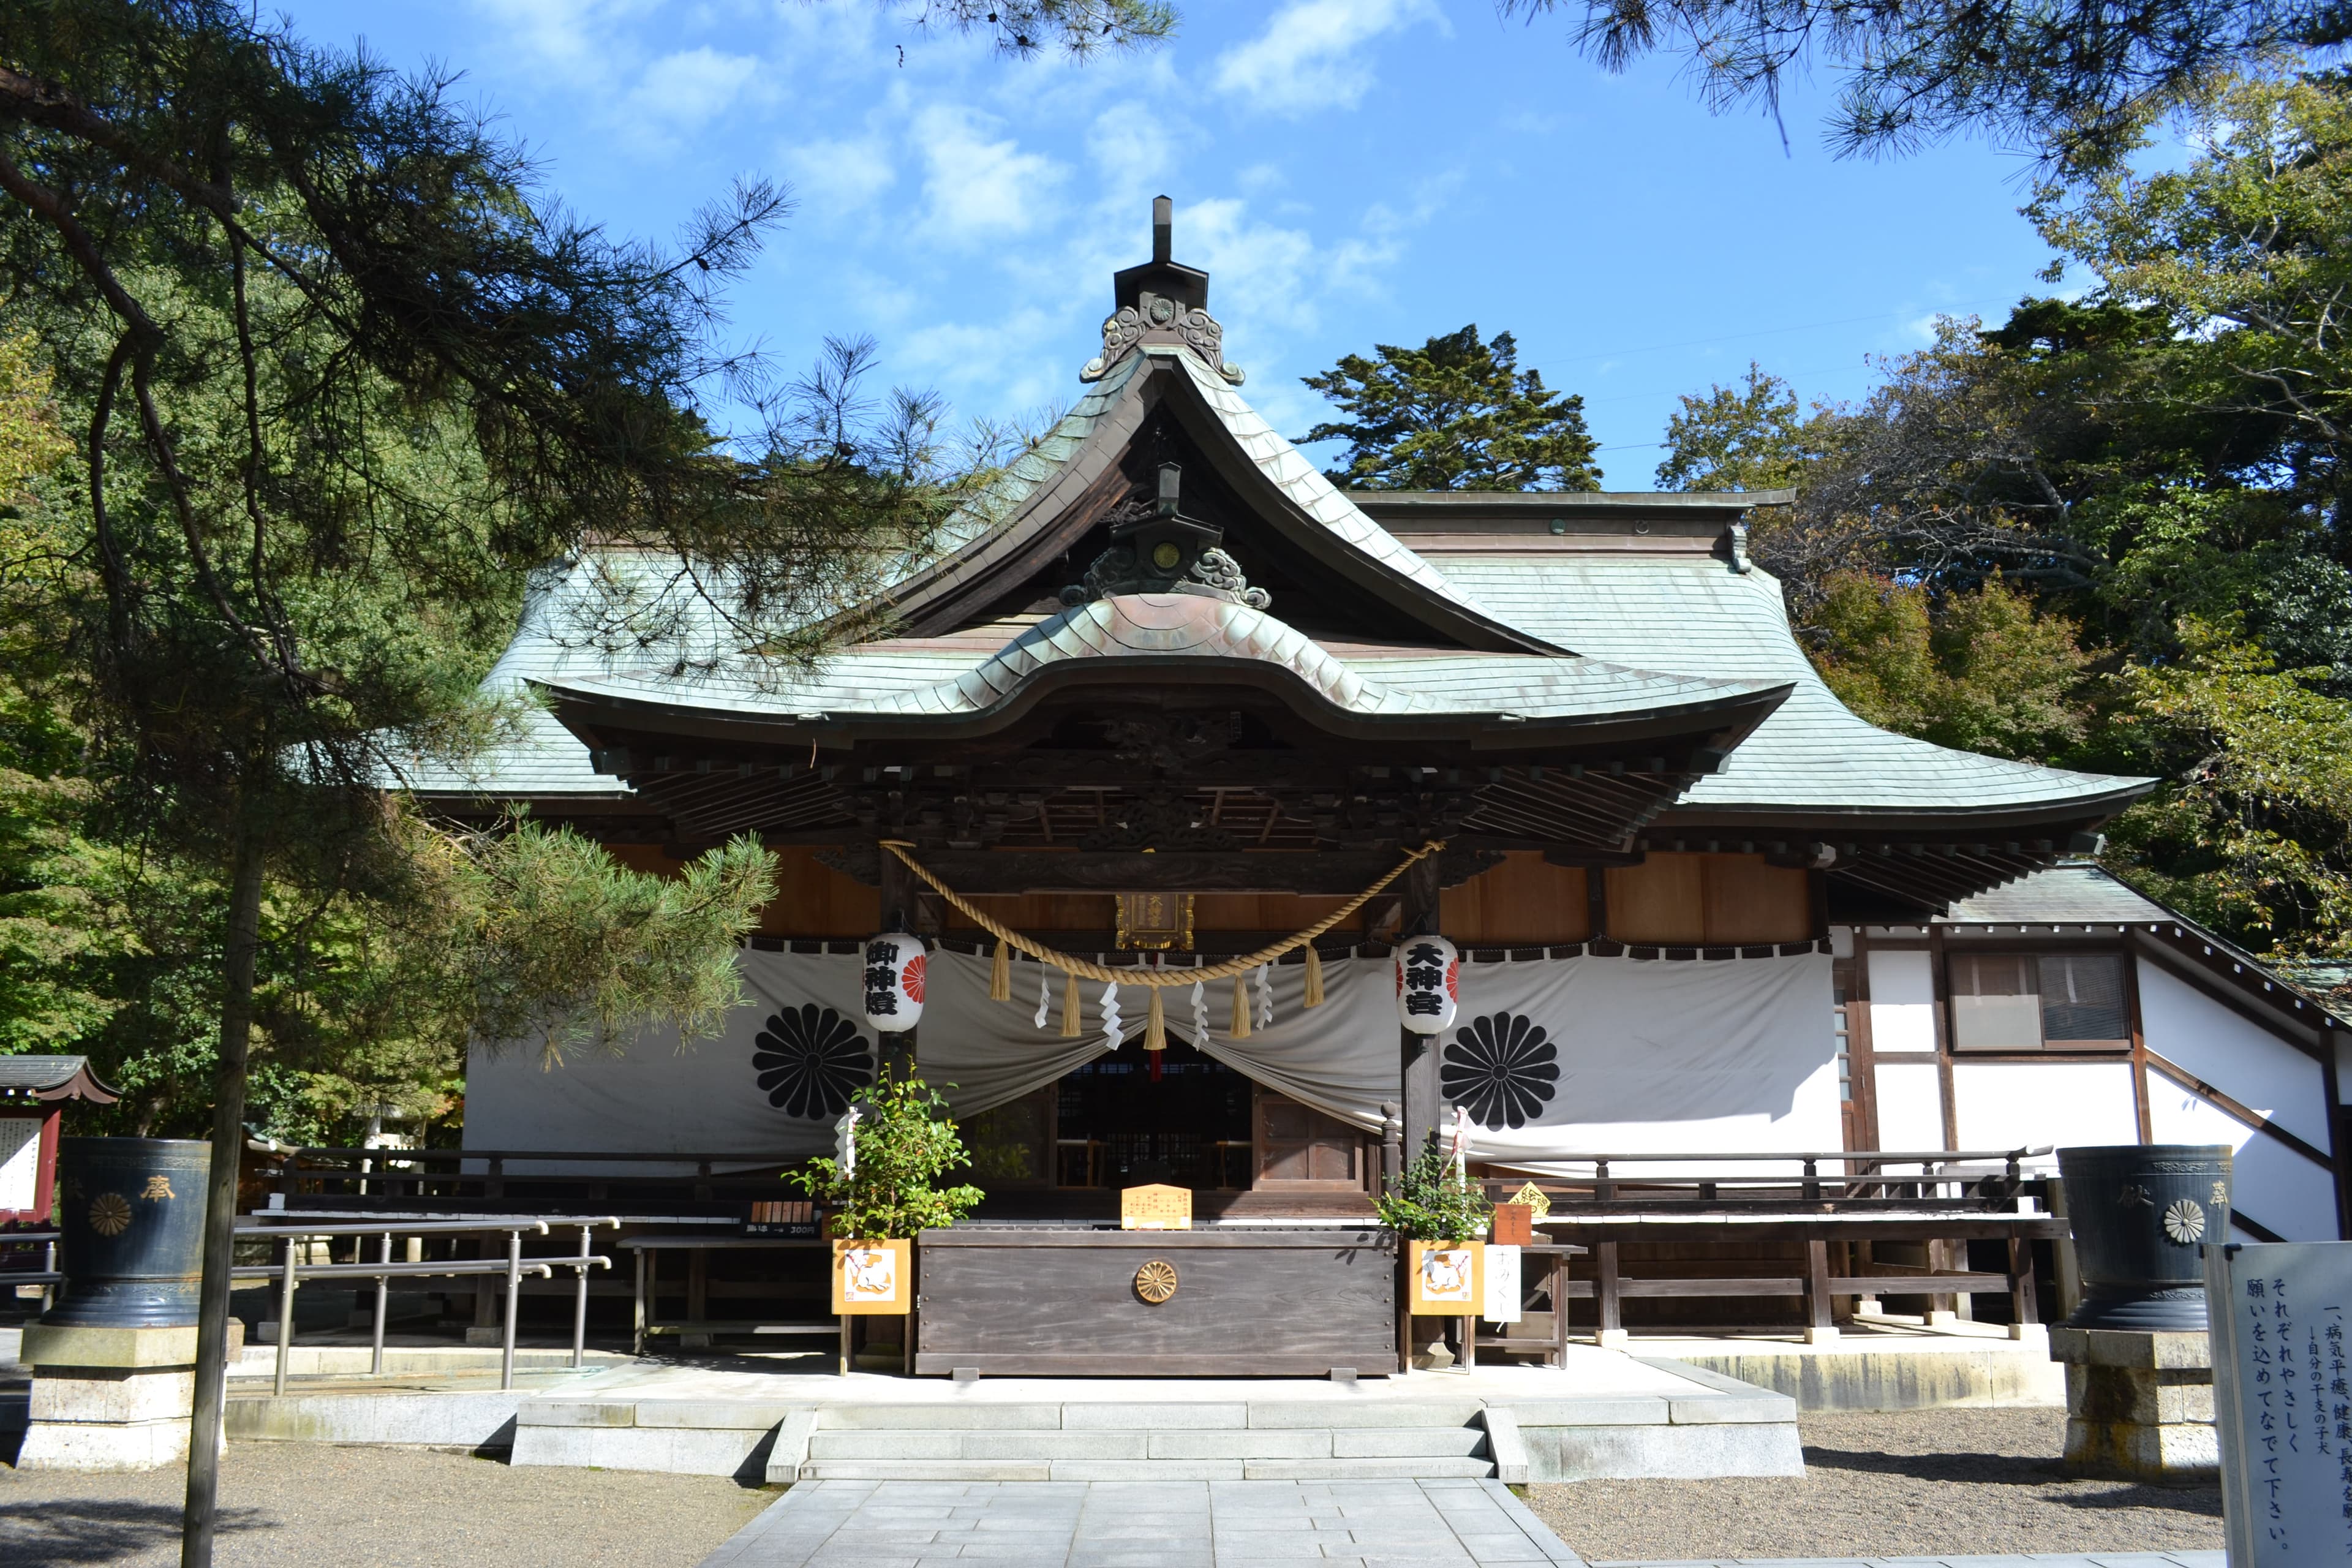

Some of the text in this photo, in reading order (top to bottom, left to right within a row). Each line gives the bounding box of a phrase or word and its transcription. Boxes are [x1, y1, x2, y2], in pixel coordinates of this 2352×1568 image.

[1406, 943, 1444, 1016] 大神宮
[140, 1175, 175, 1202] 奉
[2210, 1180, 2228, 1210] 奉
[2273, 1278, 2299, 1453] それぞれやさしく
[2308, 1340, 2331, 1455] 自分の干支の子犬
[2247, 1278, 2288, 1551] 願いを込めてなでて下さい。
